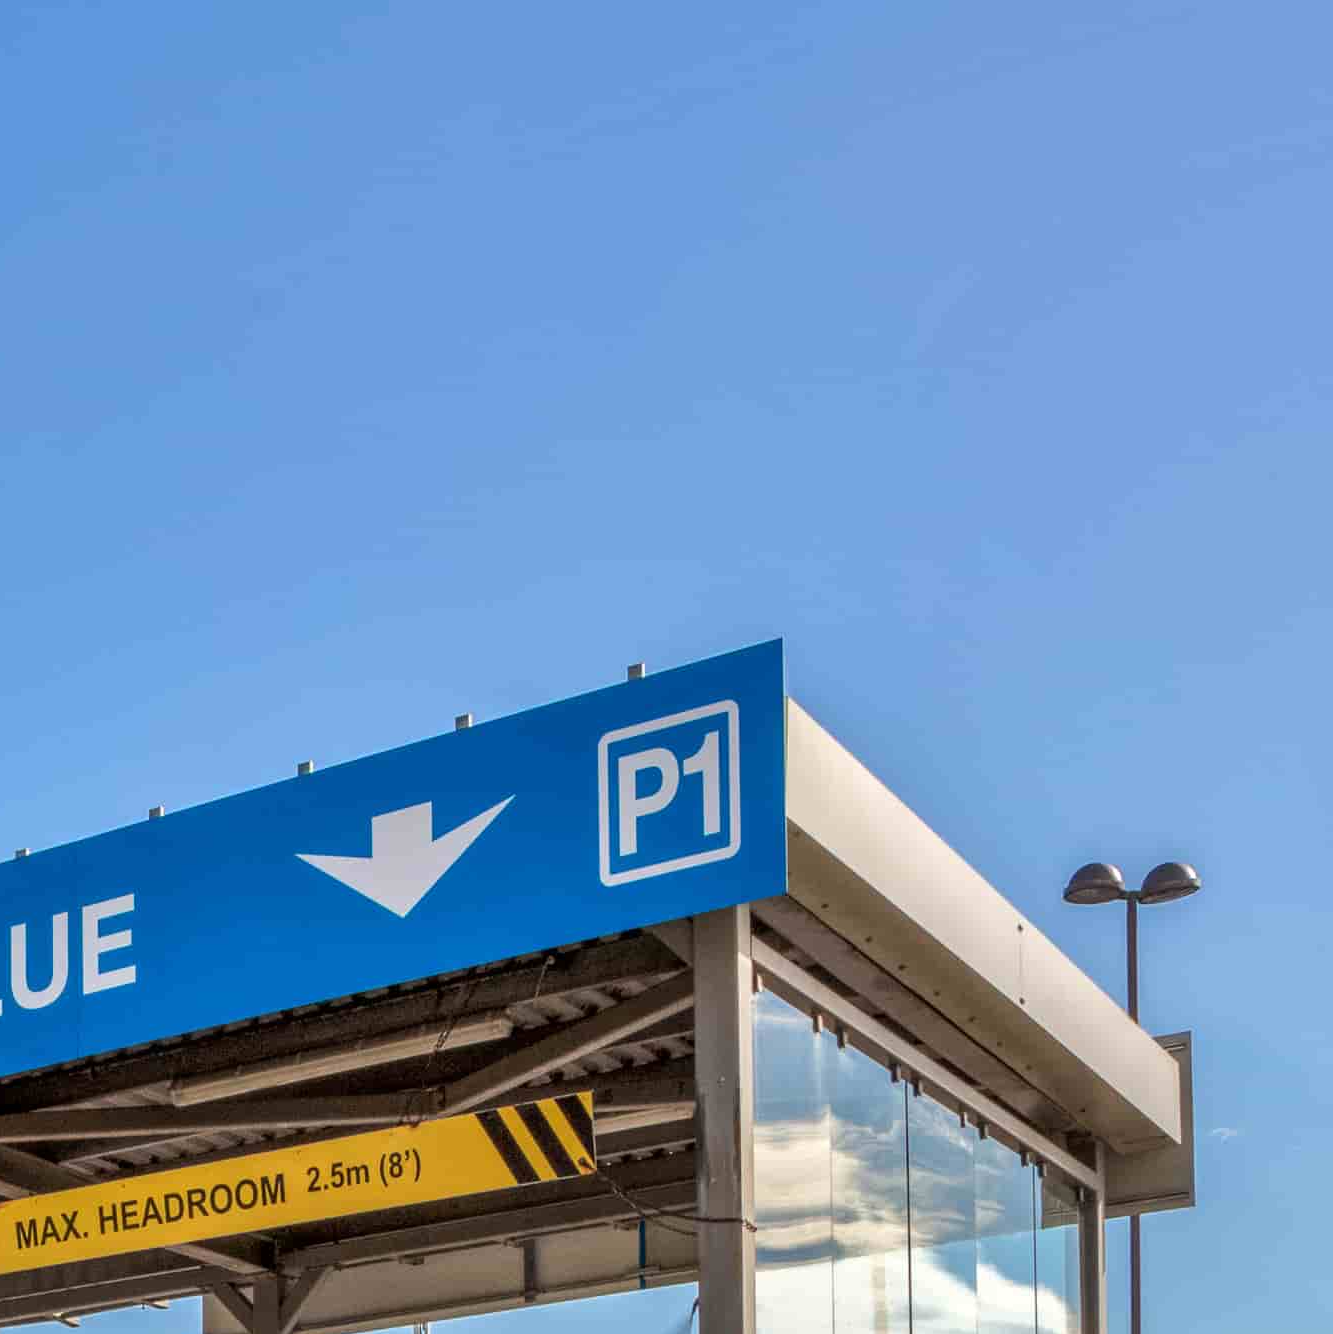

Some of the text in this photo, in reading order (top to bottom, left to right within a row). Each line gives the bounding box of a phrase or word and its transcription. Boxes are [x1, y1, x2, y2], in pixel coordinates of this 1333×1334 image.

[618, 730, 721, 857] P1
[15, 1208, 89, 1250] MAX.
[98, 1173, 287, 1235] HEADROOM
[306, 1161, 371, 1193] 2.5m
